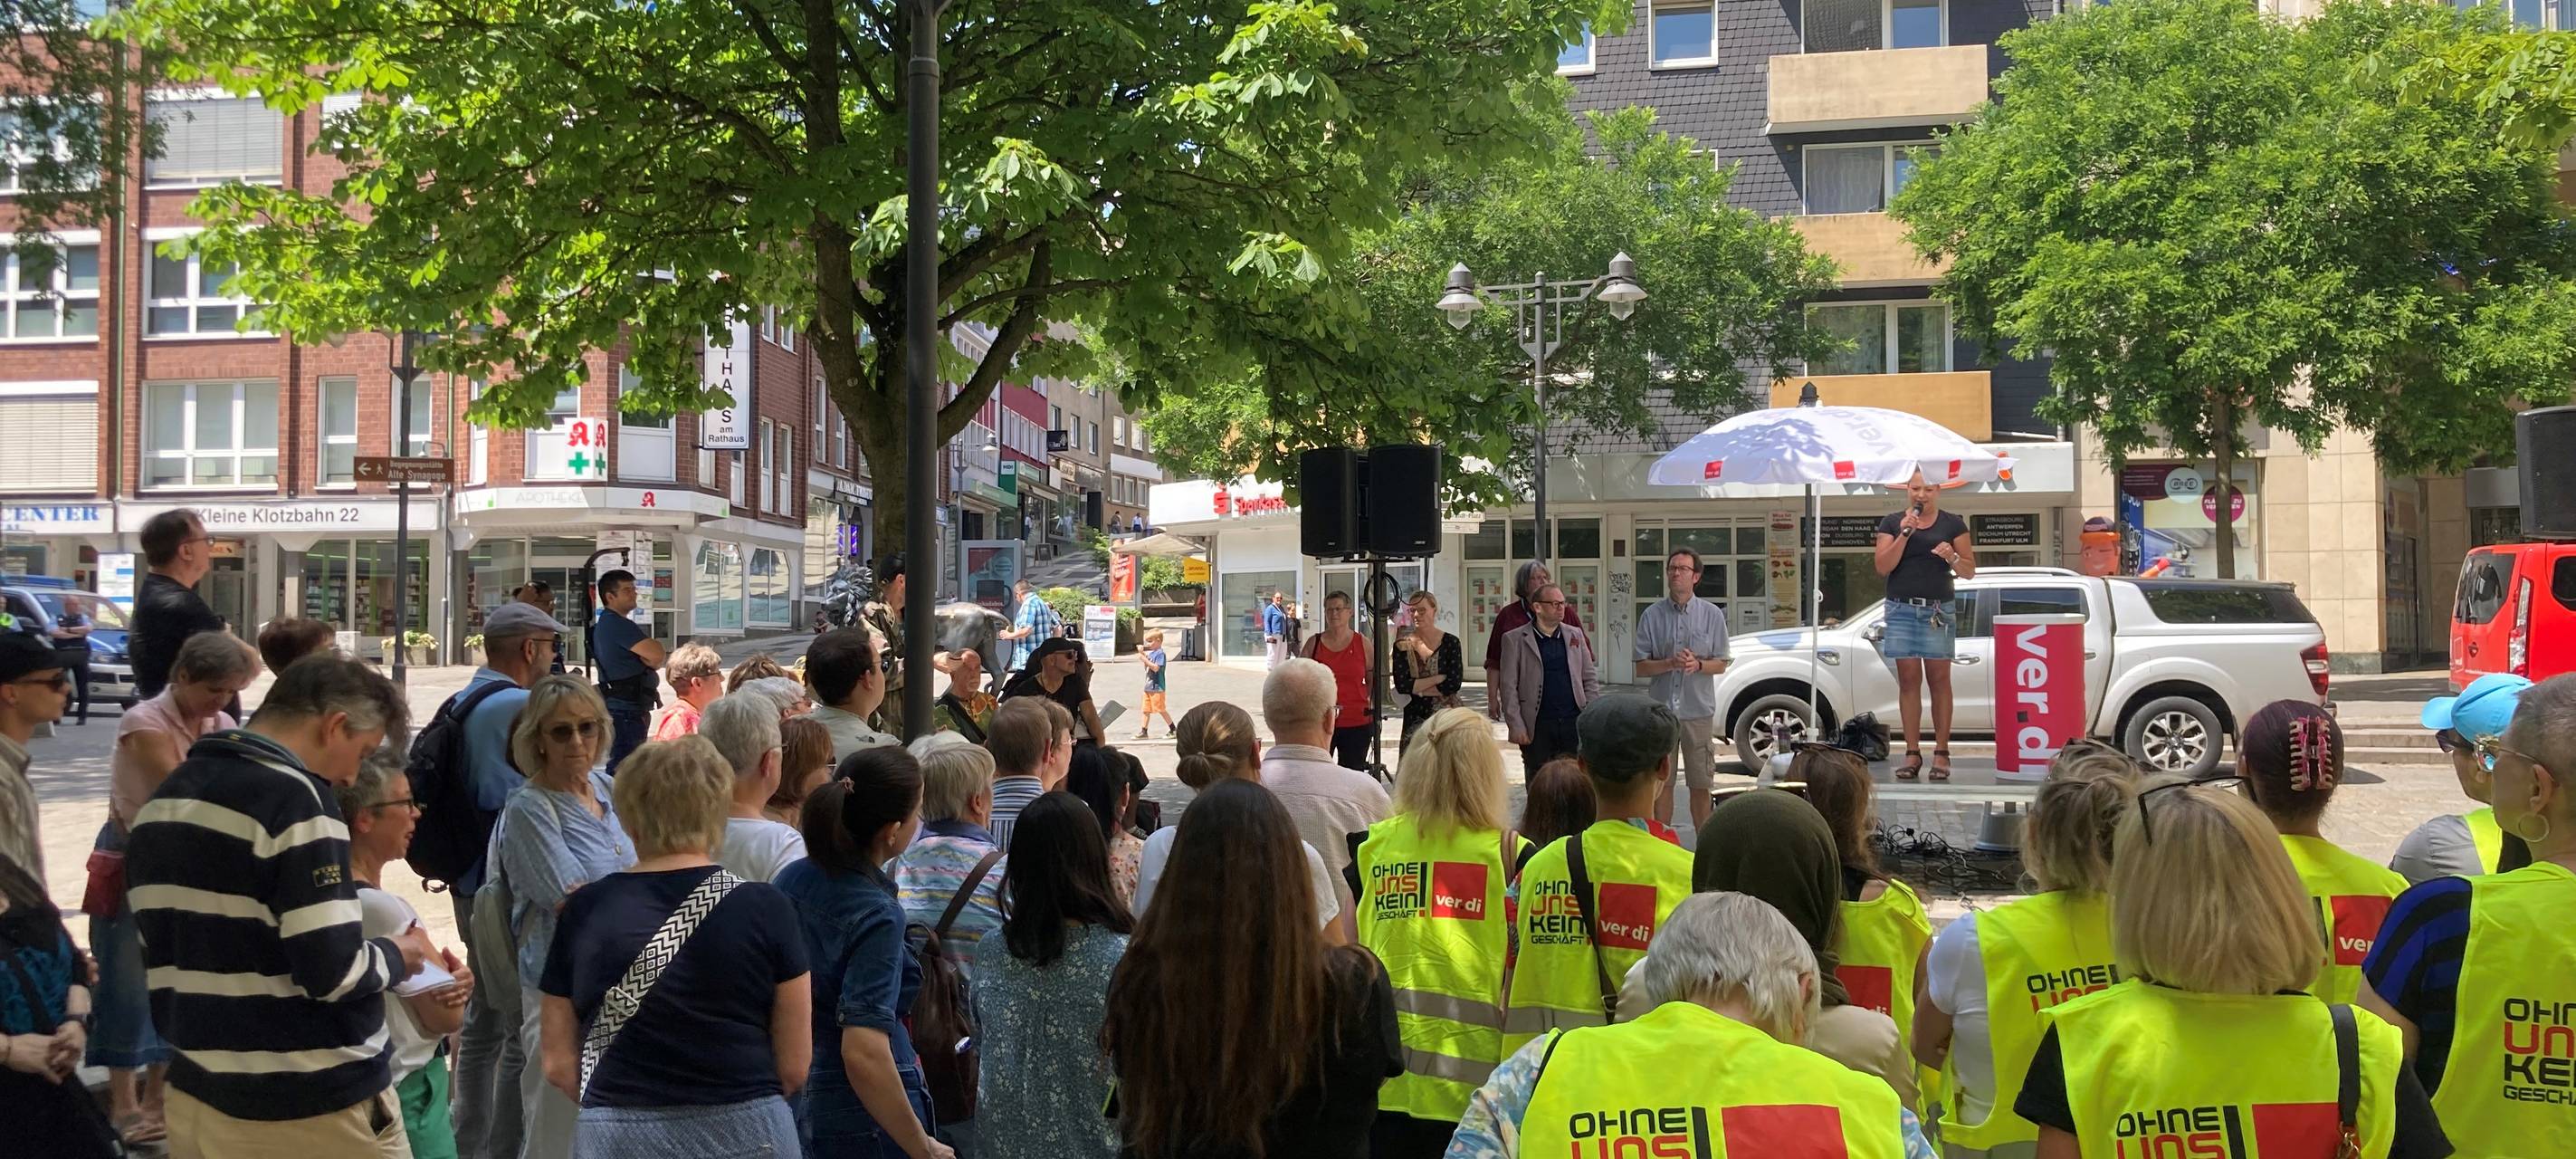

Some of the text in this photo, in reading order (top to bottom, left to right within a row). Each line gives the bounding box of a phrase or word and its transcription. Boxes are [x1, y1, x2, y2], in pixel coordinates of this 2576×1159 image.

[708, 434, 745, 443] Rathaus
[387, 470, 446, 482] Alte Synagoge
[1234, 493, 1289, 516] Sparkass
[196, 508, 359, 522] Kleine Klotzbahn 22
[1372, 861, 1418, 877] OHNE
[1375, 892, 1418, 911] KEIN
[1531, 895, 1582, 915] UNS
[1530, 915, 1584, 934] KEIN
[1531, 933, 1584, 945] GESCHÄFT
[2027, 964, 2108, 994] OHNE
[2504, 1085, 2576, 1106] GESCH
[1569, 1107, 1687, 1139] OHNE
[2116, 1106, 2220, 1137] OHNE
